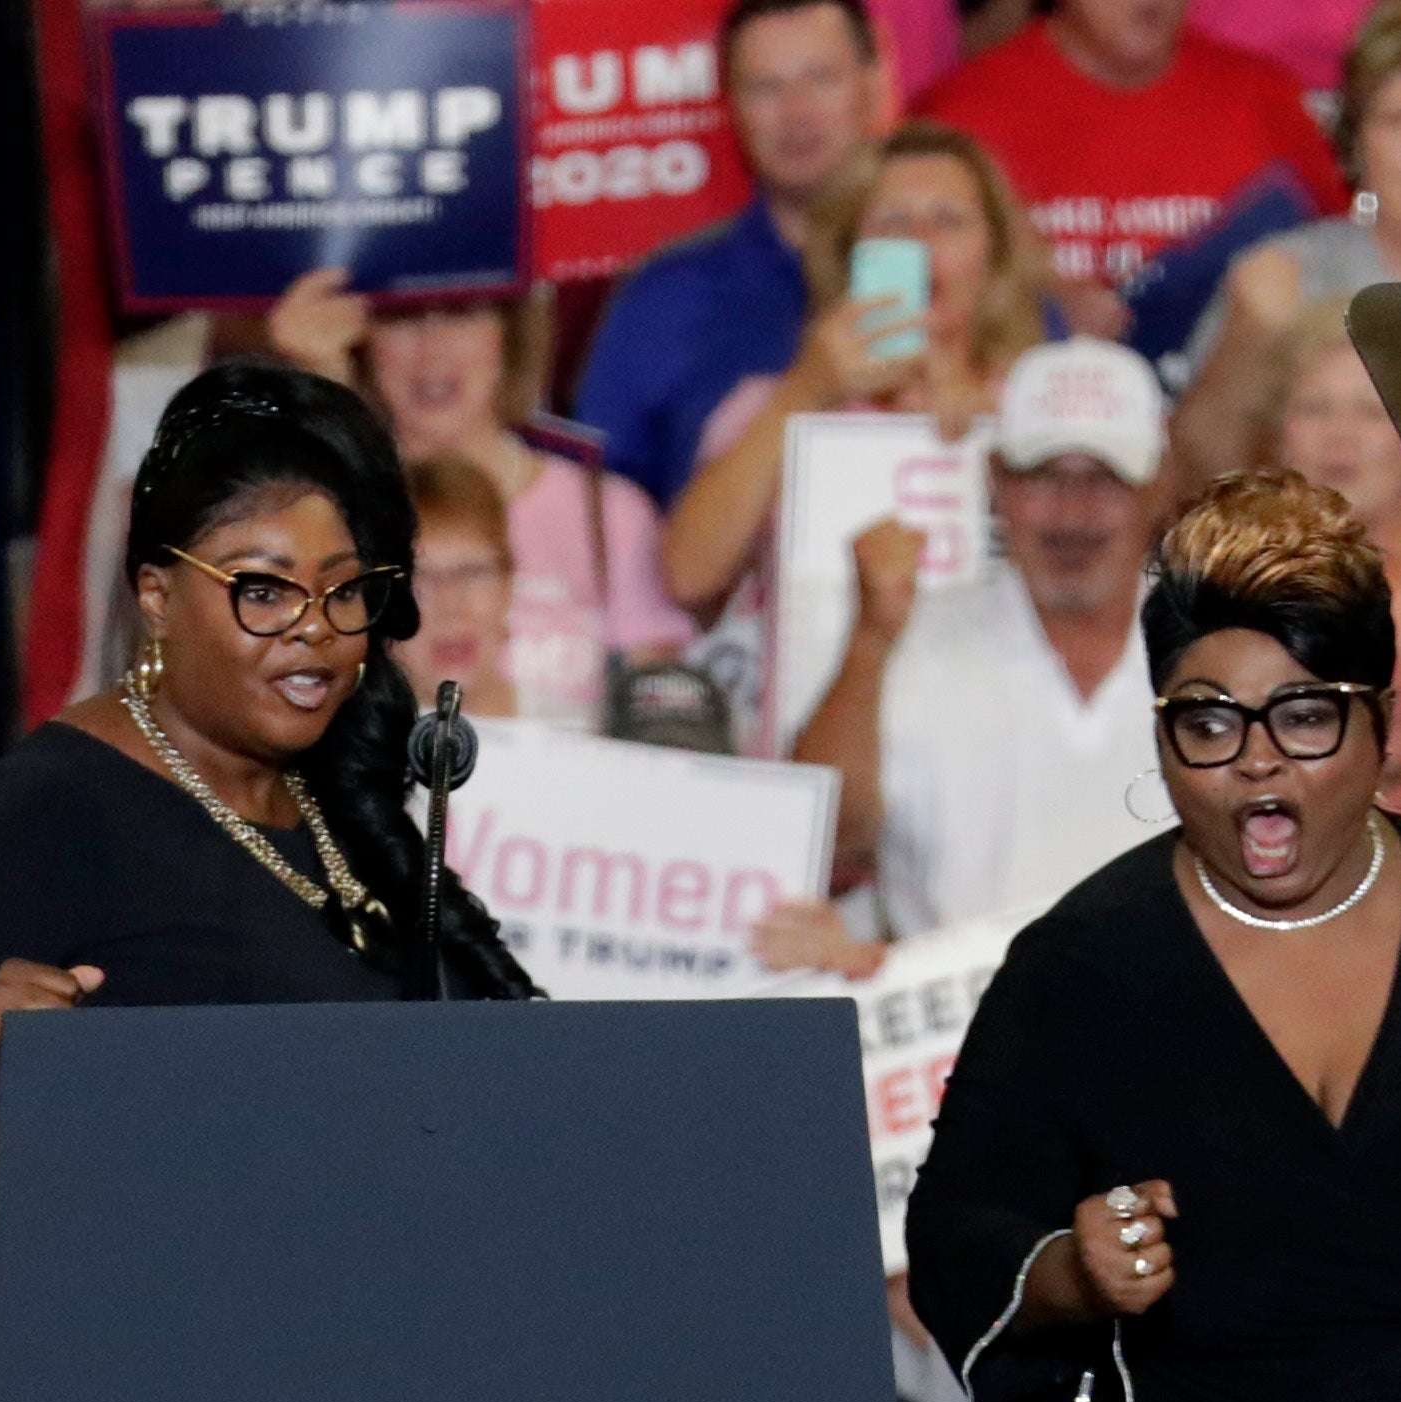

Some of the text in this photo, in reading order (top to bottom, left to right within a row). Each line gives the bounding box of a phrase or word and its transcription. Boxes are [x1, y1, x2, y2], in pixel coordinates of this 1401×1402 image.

[125, 86, 502, 157] TRUMP
[162, 150, 471, 202] PENCE
[555, 925, 741, 977] TRUMP
